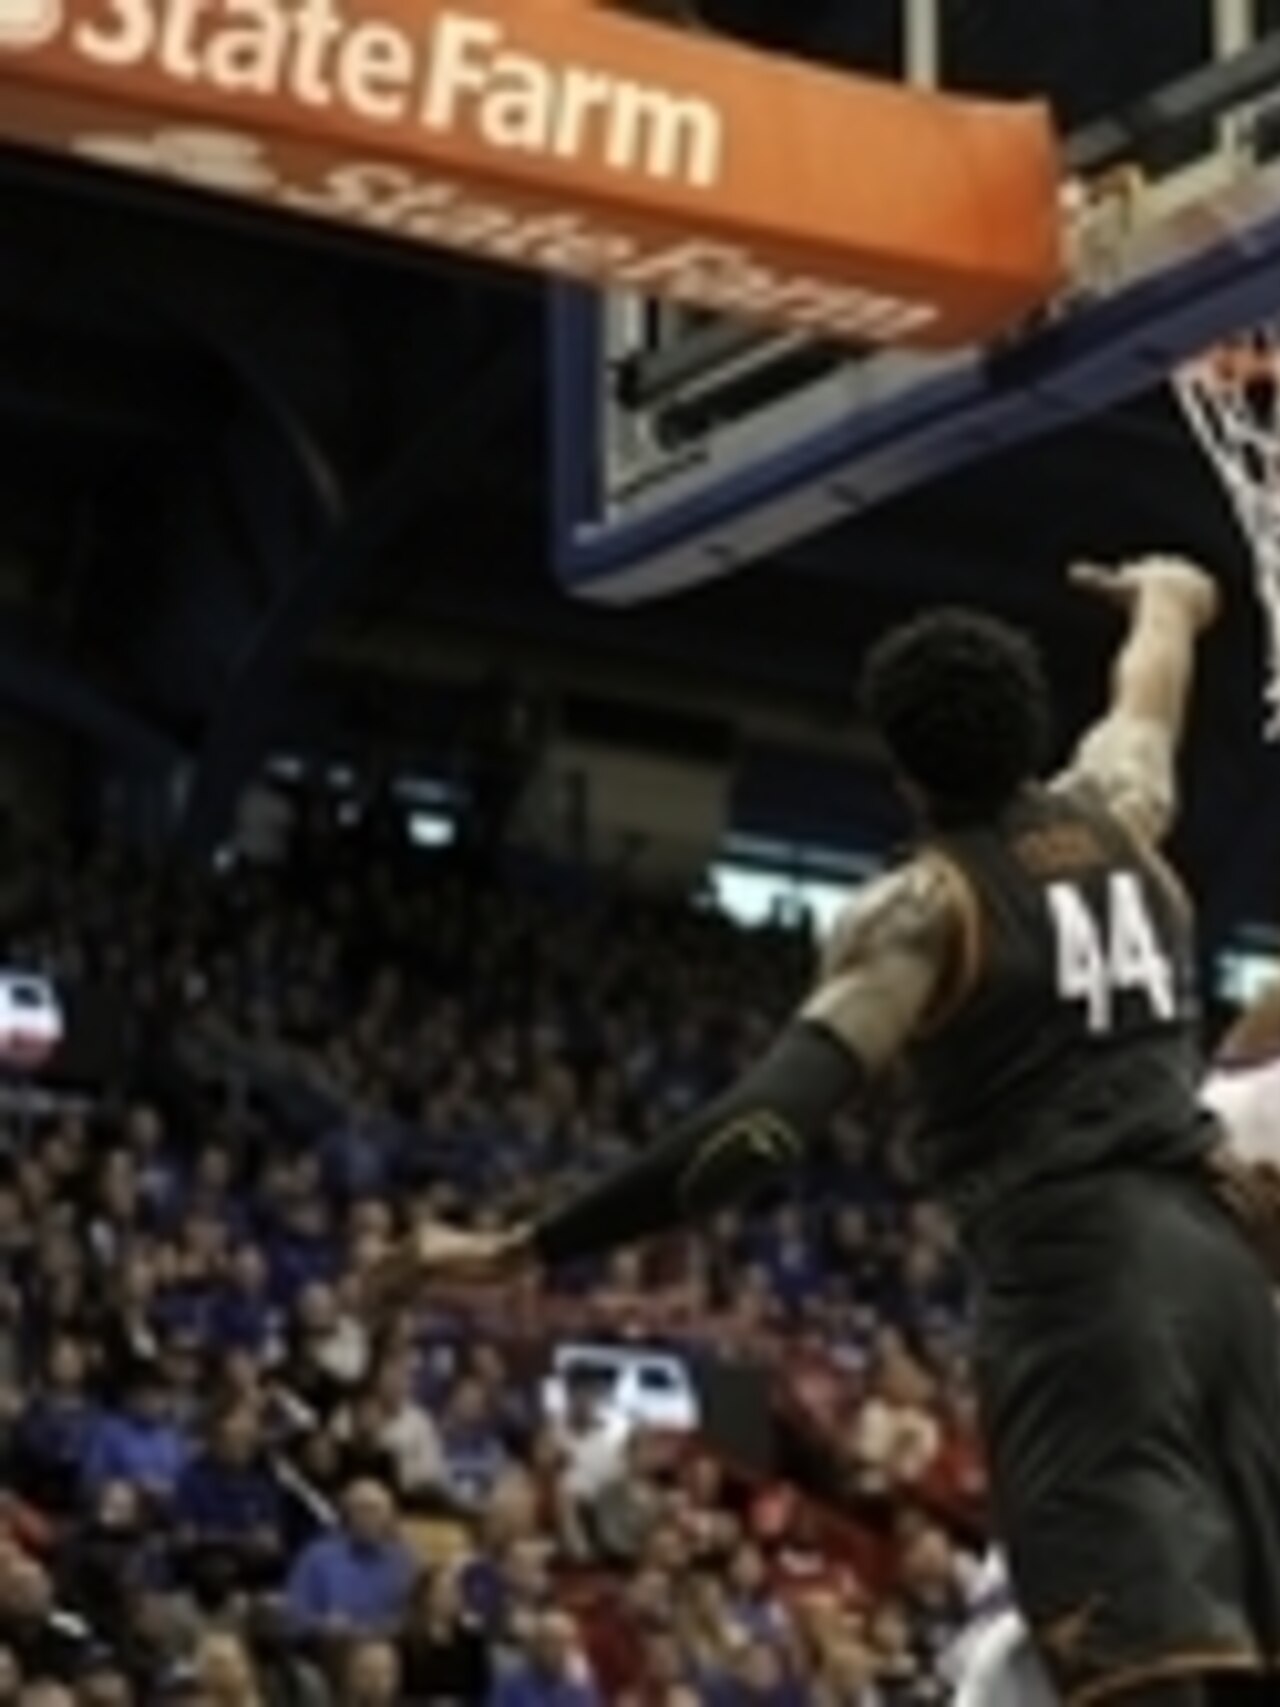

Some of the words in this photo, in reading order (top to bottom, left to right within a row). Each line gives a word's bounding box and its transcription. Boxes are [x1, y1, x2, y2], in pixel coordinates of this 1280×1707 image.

[420, 12, 722, 190] Farm
[288, 164, 637, 284] State
[606, 240, 940, 342] Farm
[1046, 870, 1176, 1034] 44
